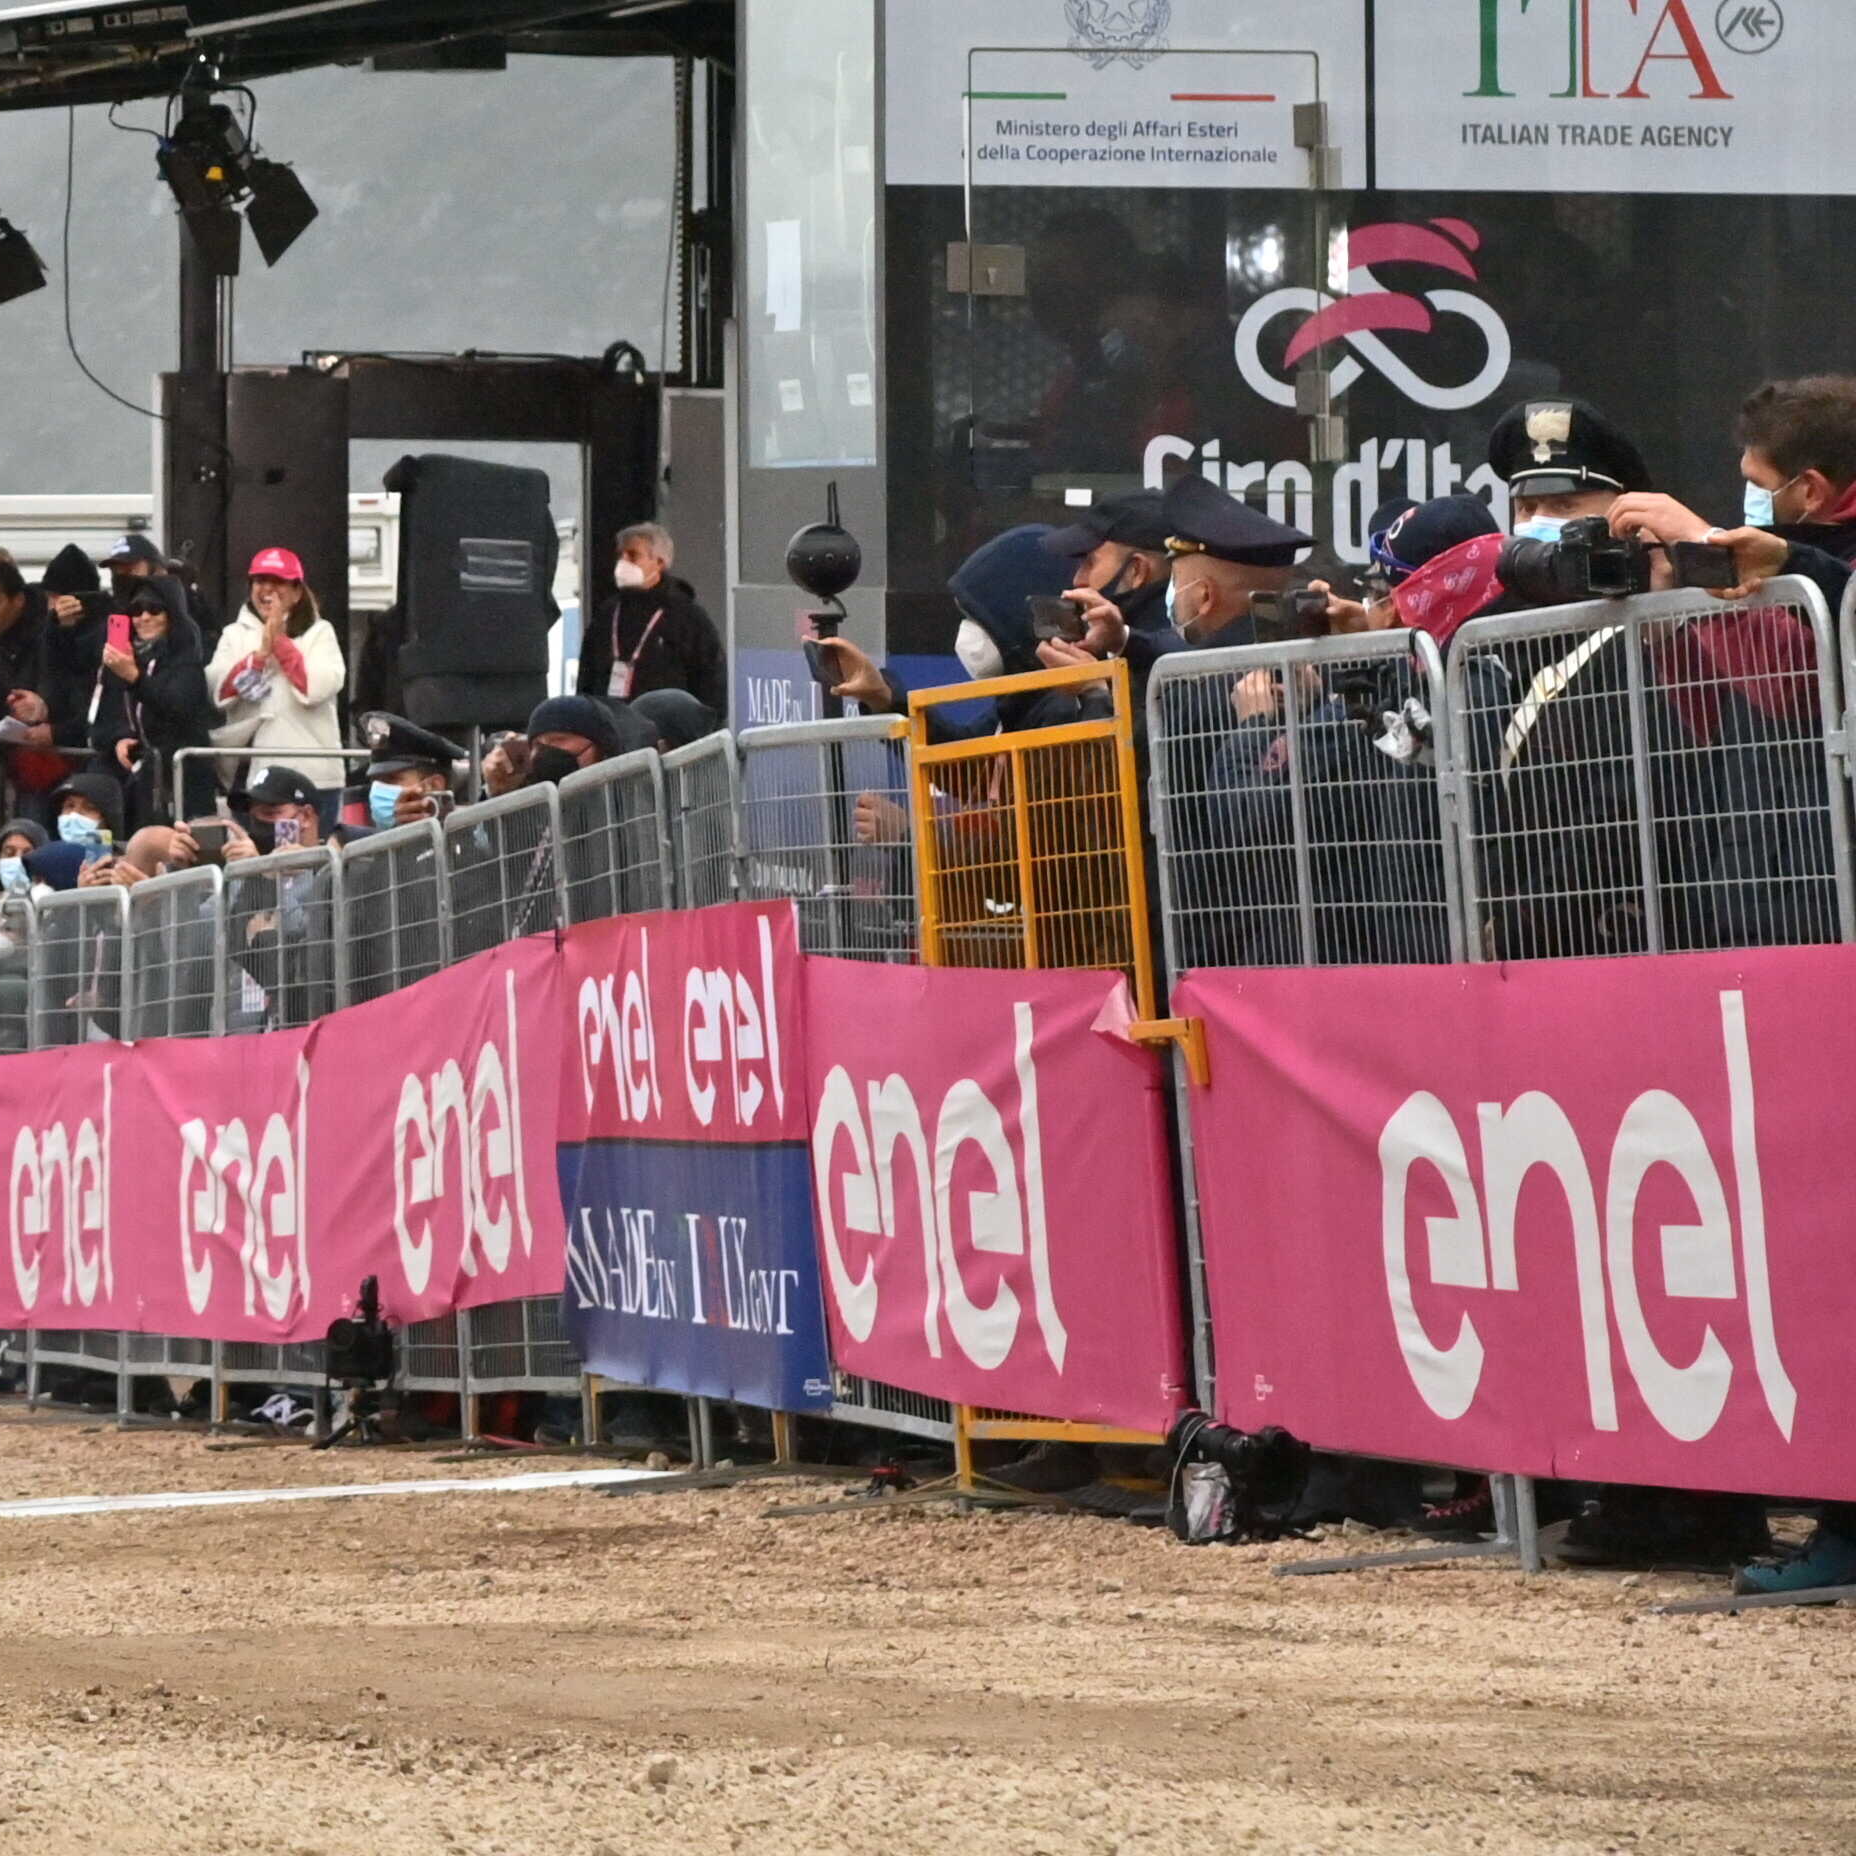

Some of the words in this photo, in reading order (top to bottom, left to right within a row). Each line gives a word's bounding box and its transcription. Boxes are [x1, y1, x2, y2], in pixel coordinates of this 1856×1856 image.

[977, 144, 1021, 161] della
[1025, 144, 1147, 167] Cooperazione
[1150, 144, 1278, 164] Internazionale
[995, 119, 1081, 138] Ministero
[1085, 119, 1129, 142] degli
[1132, 119, 1183, 138] Affari
[1186, 120, 1239, 139] Esteri
[1460, 122, 1551, 148] ITALIAN
[1556, 123, 1630, 149] TRADE
[1633, 124, 1734, 150] AGENCY
[747, 677, 792, 724] MADE
[578, 926, 663, 1122] enel
[687, 915, 785, 1127] enel
[9, 1062, 113, 1311] enel
[181, 1050, 311, 1321] enel
[393, 968, 533, 1296] enel
[813, 1000, 1069, 1376] enel
[1378, 989, 1799, 1444] enel
[565, 1204, 659, 1318] MADE
